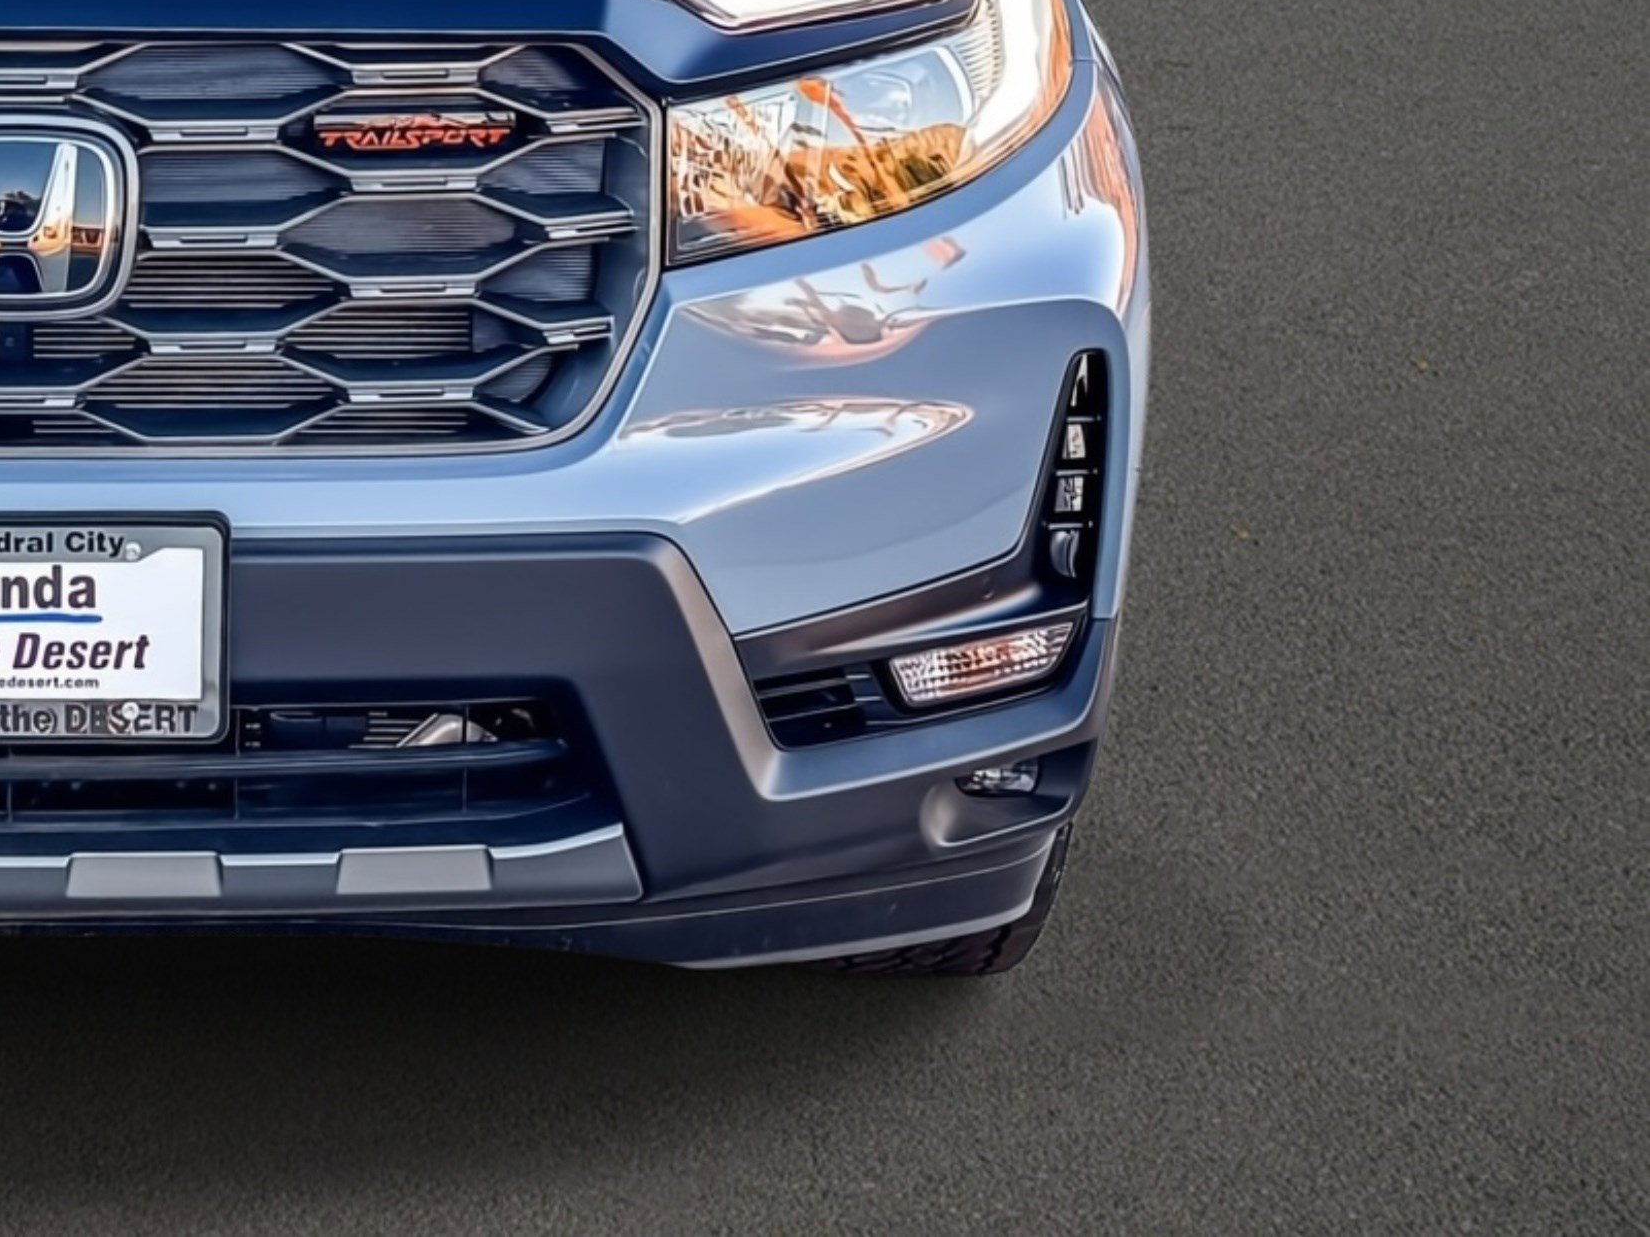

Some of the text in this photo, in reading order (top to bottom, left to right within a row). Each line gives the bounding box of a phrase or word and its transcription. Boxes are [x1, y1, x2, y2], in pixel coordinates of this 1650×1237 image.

[319, 129, 511, 150] TRAILSPORT
[65, 531, 125, 560] City
[12, 633, 151, 670] Desert
